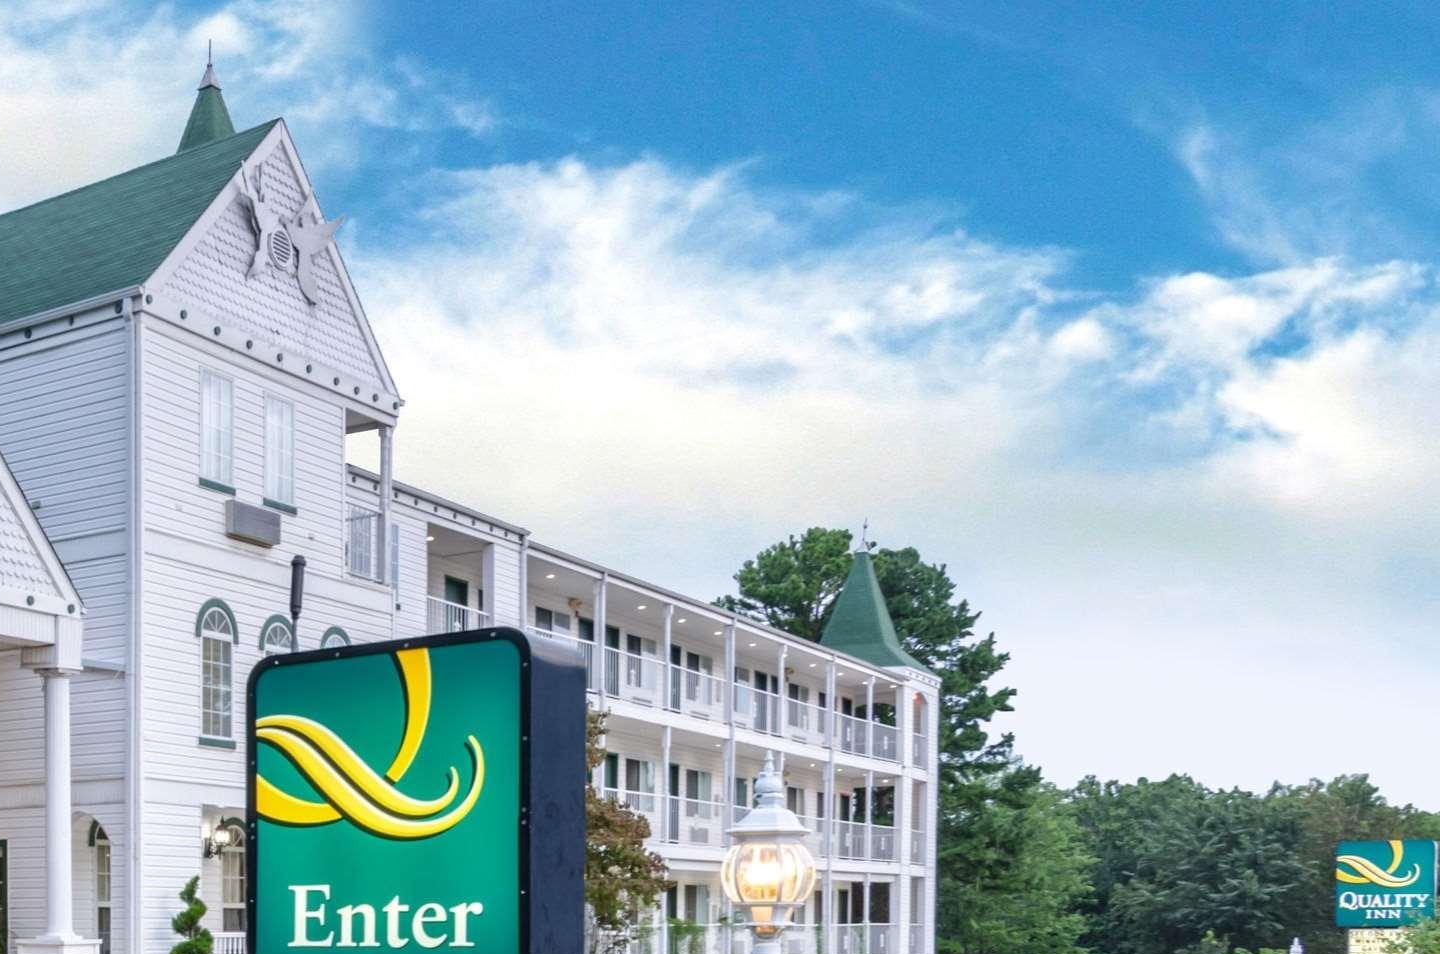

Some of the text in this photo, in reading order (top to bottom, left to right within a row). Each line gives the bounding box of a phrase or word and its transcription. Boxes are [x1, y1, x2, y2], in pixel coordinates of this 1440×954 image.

[1339, 891, 1430, 910] QUALITY
[287, 883, 484, 949] Enter
[1365, 909, 1401, 919] INN
